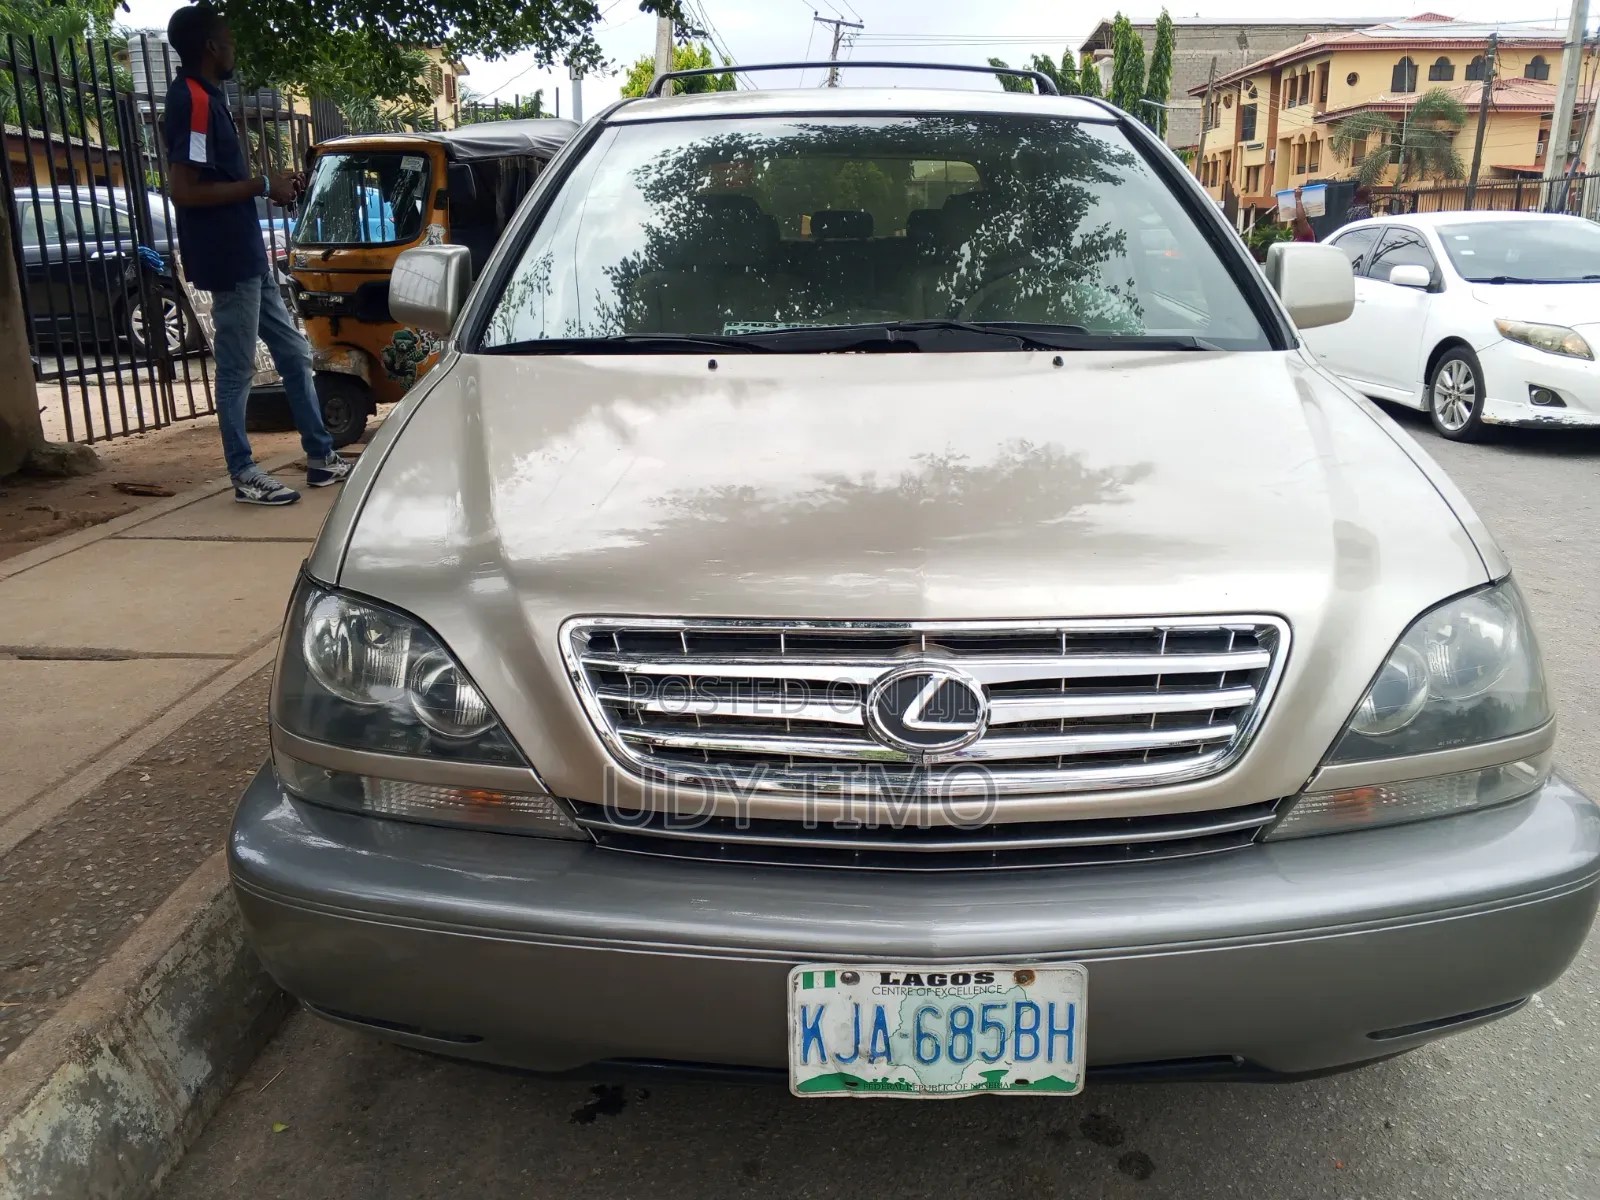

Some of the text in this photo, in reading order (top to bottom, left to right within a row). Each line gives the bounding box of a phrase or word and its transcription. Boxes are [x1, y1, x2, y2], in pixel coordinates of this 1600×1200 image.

[880, 971, 995, 987] LAGOS
[871, 984, 1003, 997] CENTRE OF EXCELLENCE
[863, 1083, 905, 1091] FEDERAL
[906, 1083, 953, 1092] REPUBLIC
[971, 1081, 1010, 1090] NIGERIA
